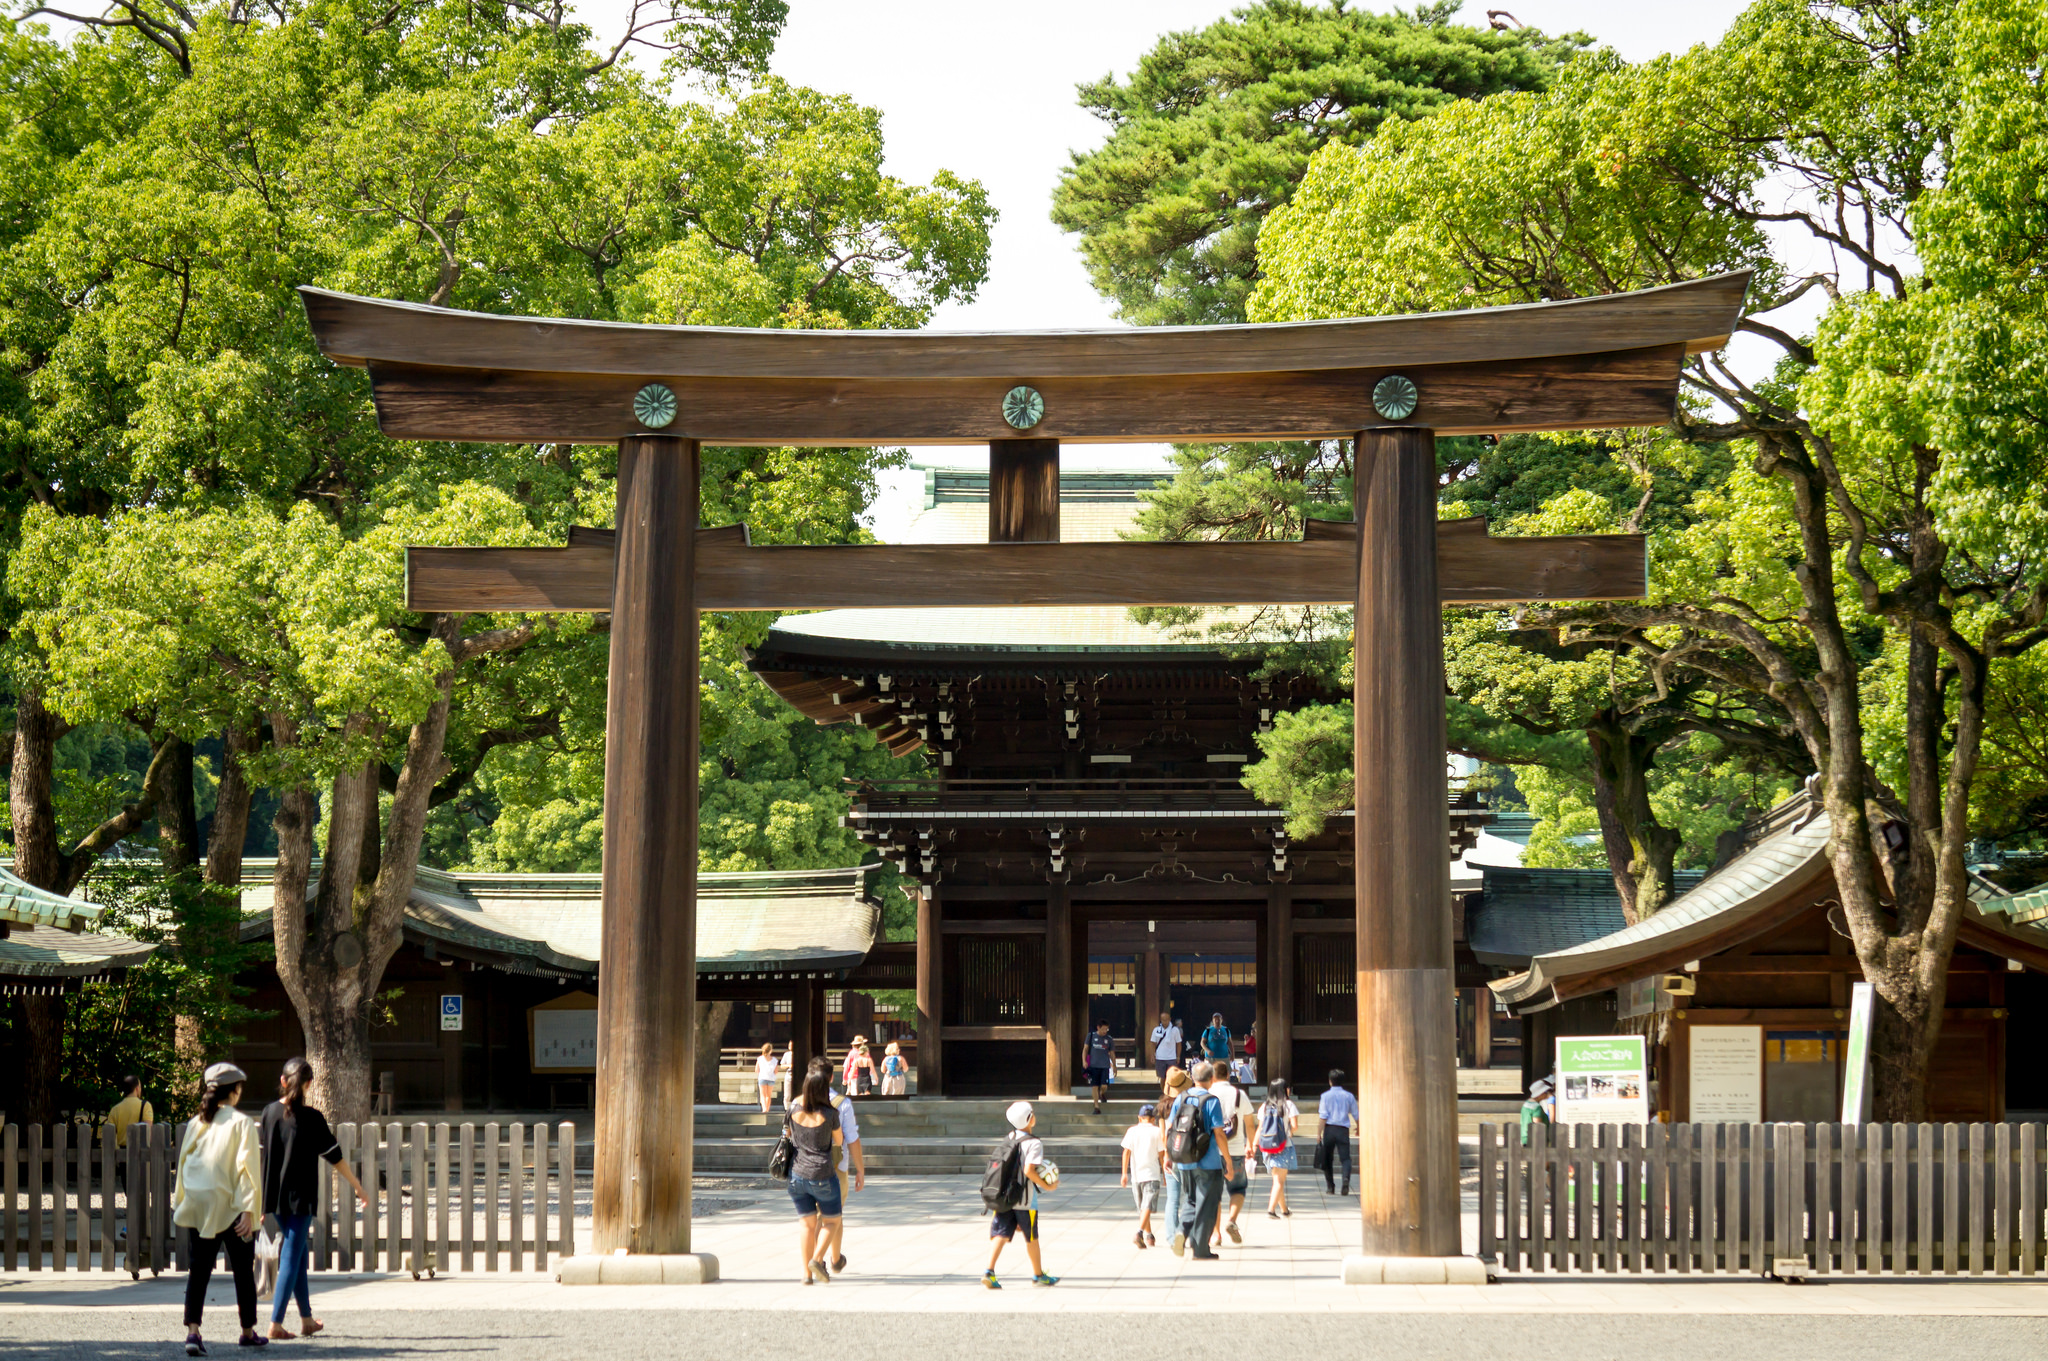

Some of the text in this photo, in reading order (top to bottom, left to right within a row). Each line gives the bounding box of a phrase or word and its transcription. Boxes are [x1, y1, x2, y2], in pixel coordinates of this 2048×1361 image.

[1570, 1049, 1633, 1062] 入会のご案内
